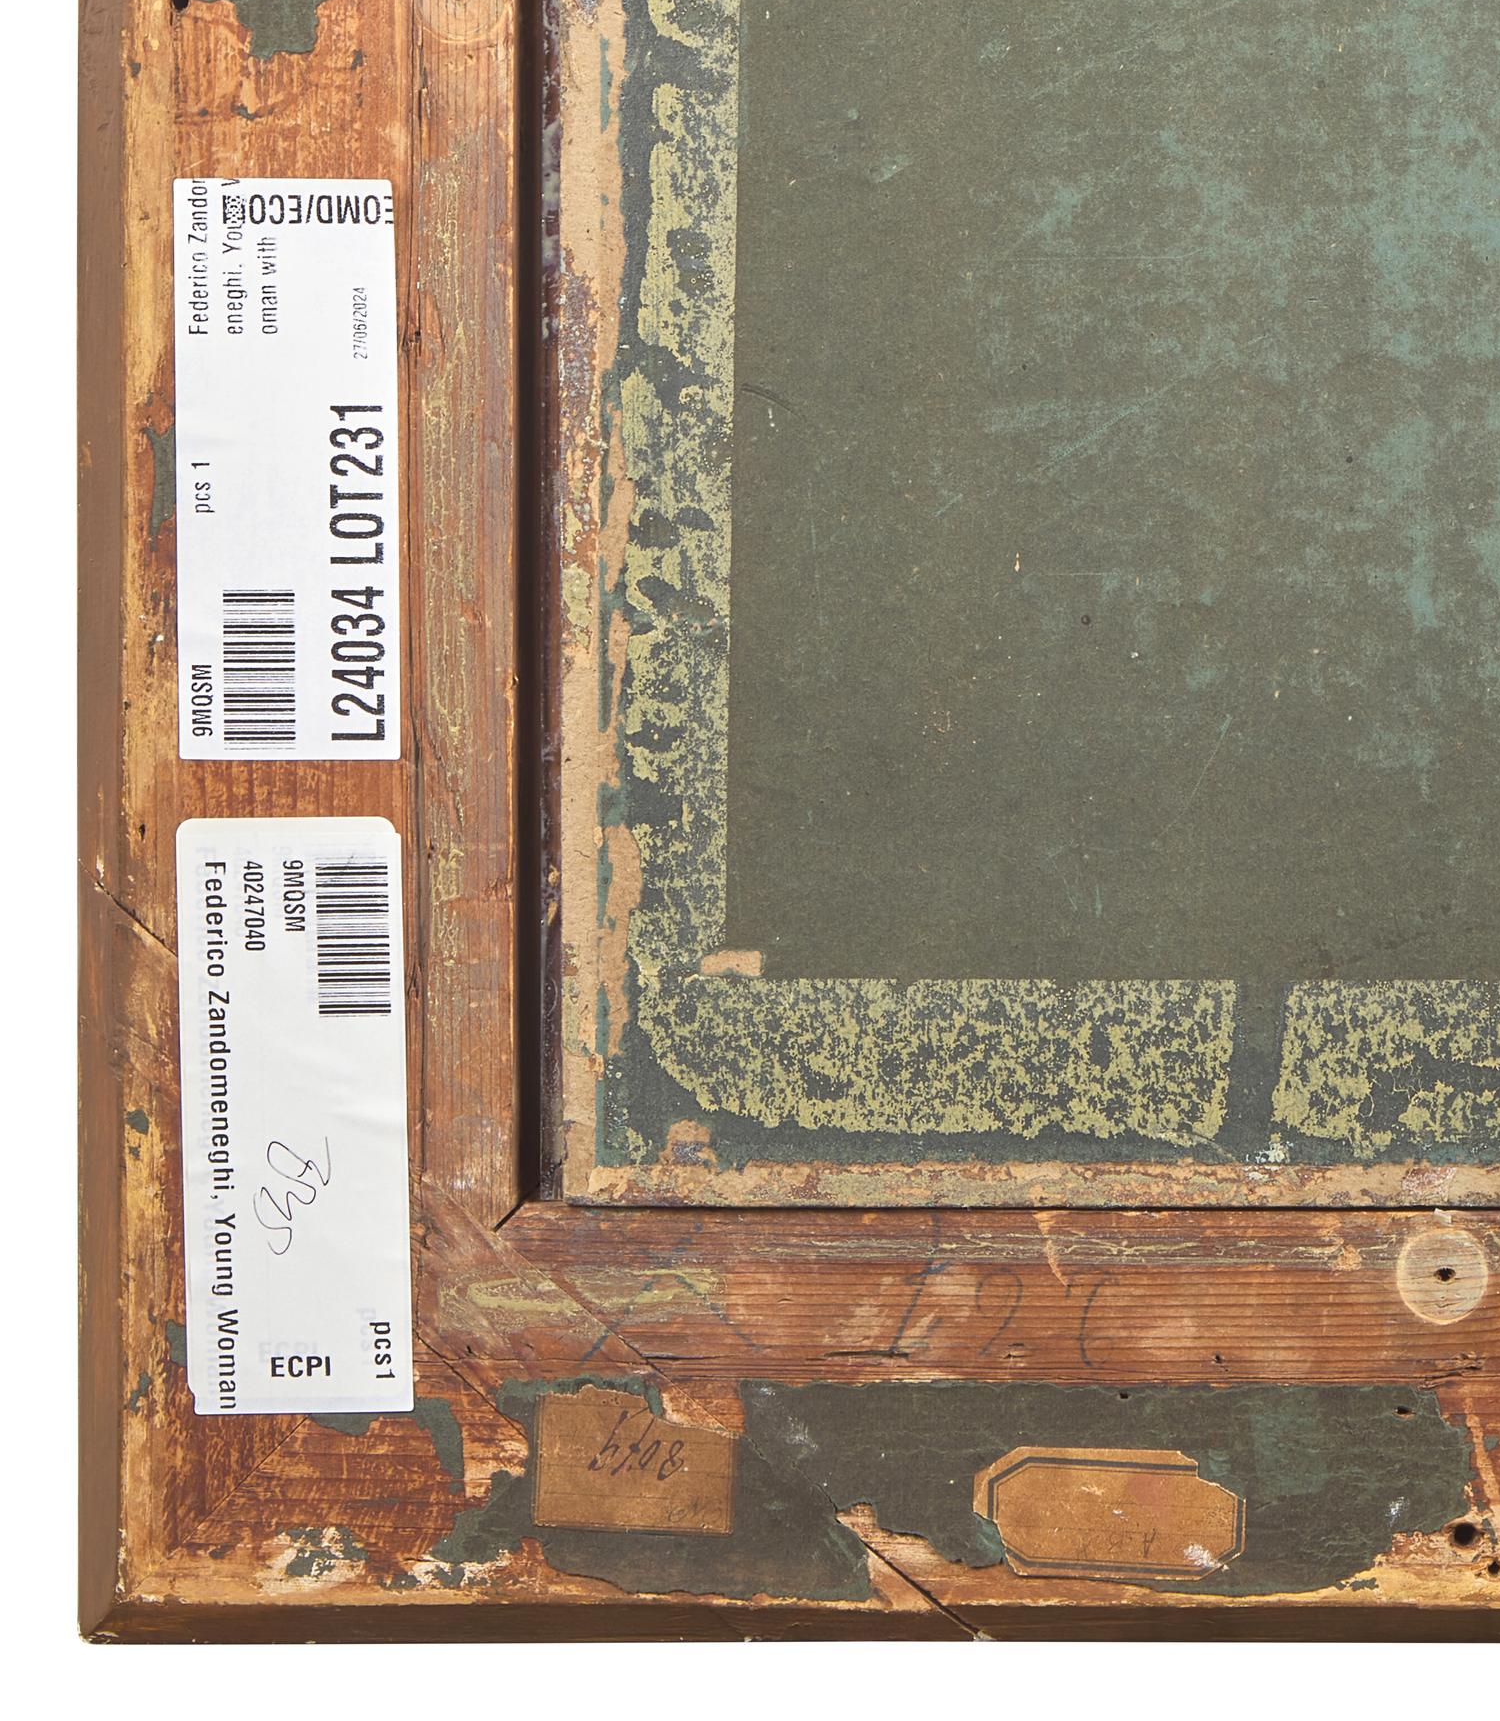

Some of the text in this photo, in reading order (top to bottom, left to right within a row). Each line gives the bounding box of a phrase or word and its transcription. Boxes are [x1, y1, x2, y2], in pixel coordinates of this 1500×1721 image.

[187, 252, 209, 336] Federico
[257, 236, 279, 335] oman with
[192, 481, 213, 515] pcs
[330, 286, 386, 742] L24034 LOT231 27/06/2024
[191, 662, 213, 737] 9MQSM
[243, 860, 266, 951] 40247040
[283, 859, 306, 933] 9MQSM
[204, 861, 238, 1410] Federico Zandomeneghi, Young Woman
[270, 1356, 331, 1378] ECPI
[368, 1321, 396, 1381] pcs1
